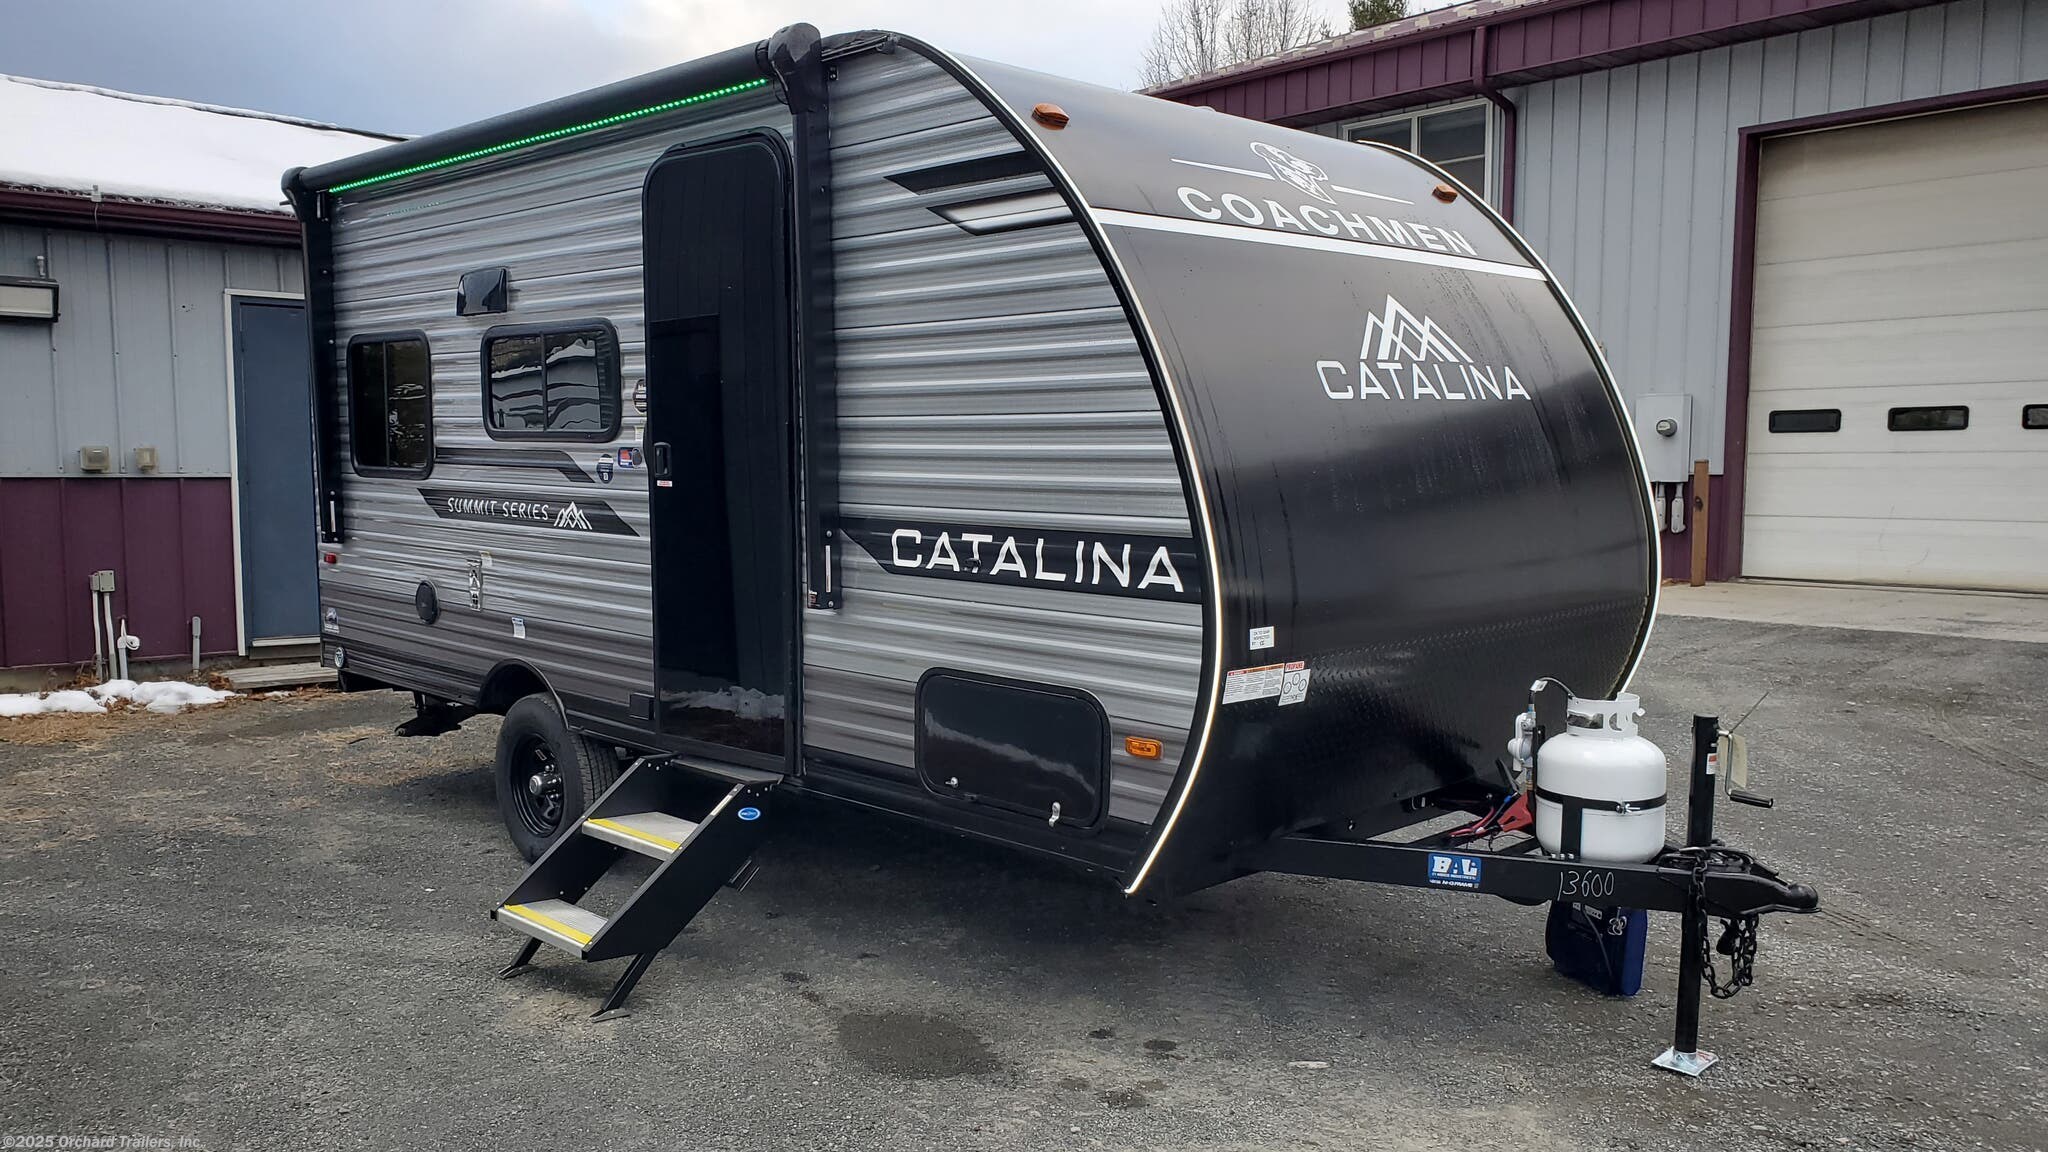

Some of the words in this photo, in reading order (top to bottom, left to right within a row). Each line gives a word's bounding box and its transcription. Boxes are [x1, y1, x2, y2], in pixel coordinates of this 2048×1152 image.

[1176, 186, 1479, 256] COACHMEN
[1316, 360, 1531, 400] CATALINA
[447, 497, 497, 515] SUMMIT
[502, 501, 549, 521] SERIES
[891, 528, 1184, 592] CATALINA
[1557, 870, 1614, 901] 13600
